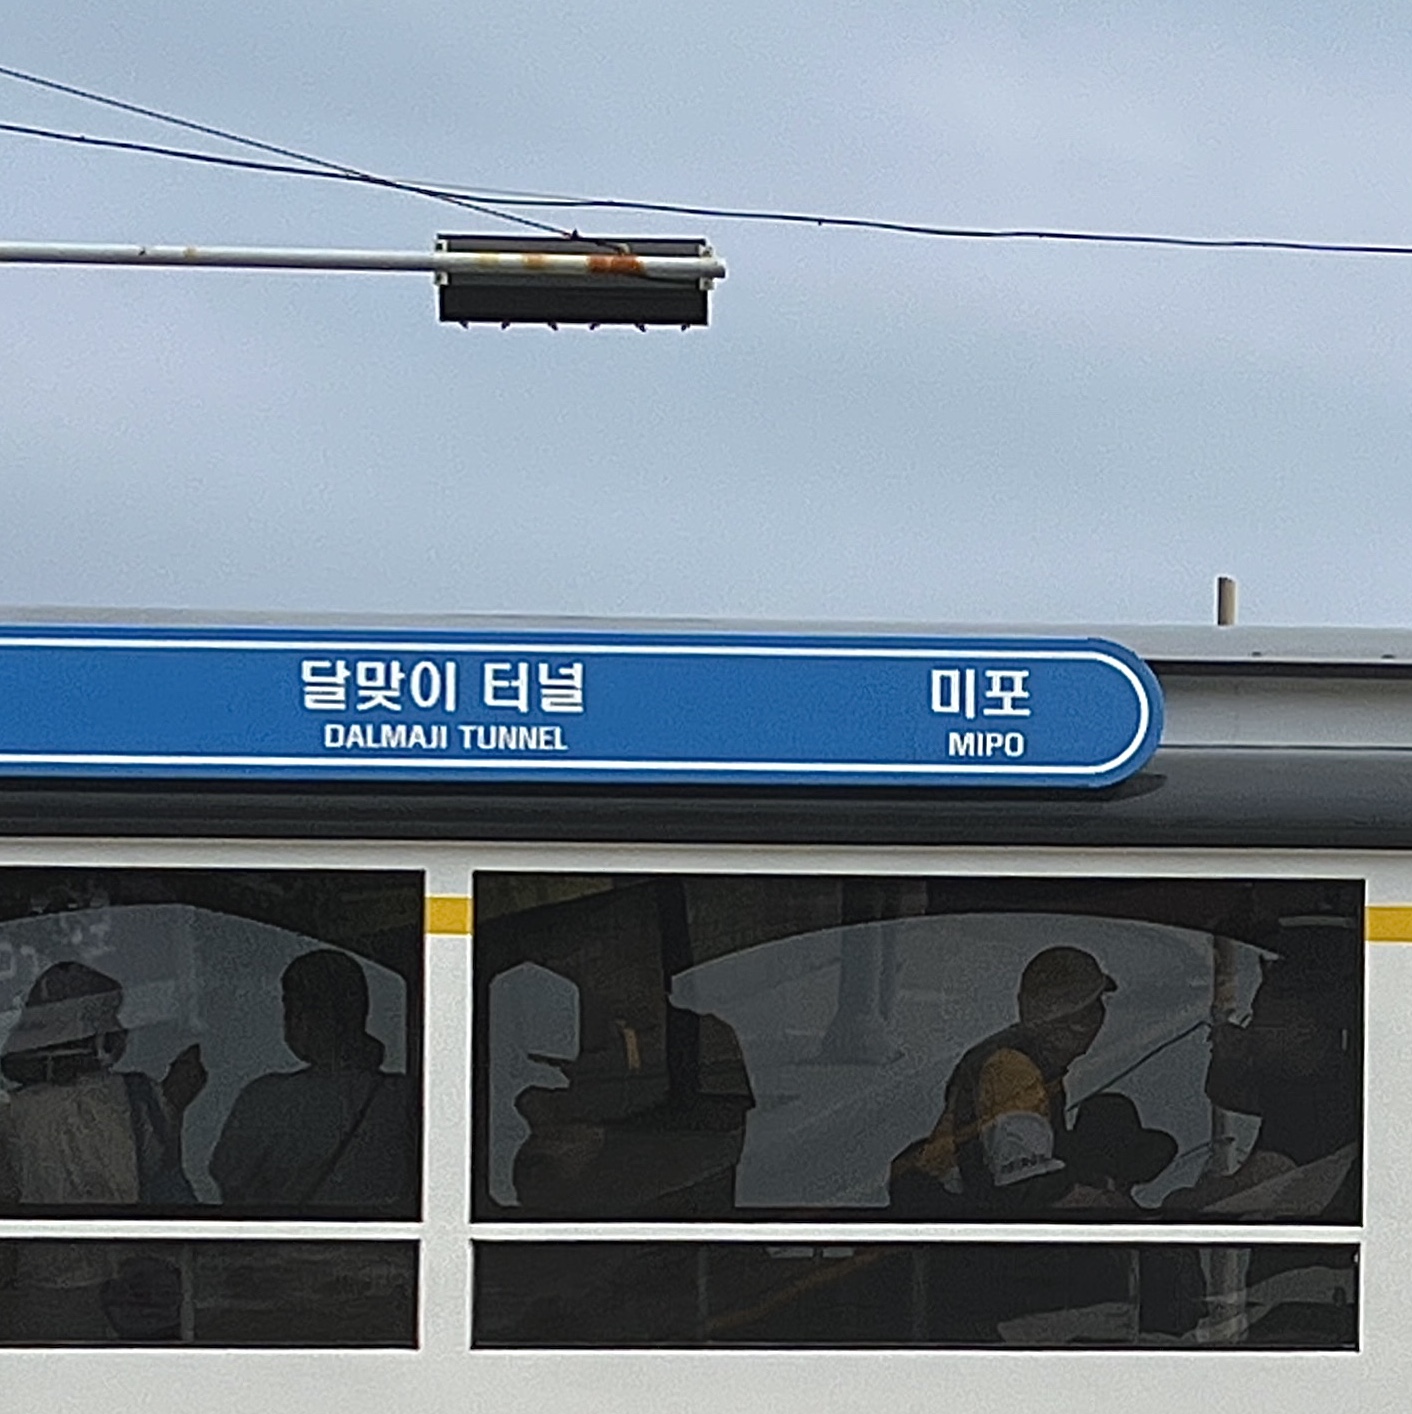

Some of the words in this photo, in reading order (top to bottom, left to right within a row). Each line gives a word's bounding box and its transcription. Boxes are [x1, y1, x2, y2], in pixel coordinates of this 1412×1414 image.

[301, 659, 457, 713] 달맞이
[483, 661, 584, 714] 터널
[930, 668, 1032, 720] 미포
[324, 723, 448, 750] DALMAJI
[457, 724, 569, 751] TUNNEL
[948, 731, 1025, 758] MIPO
